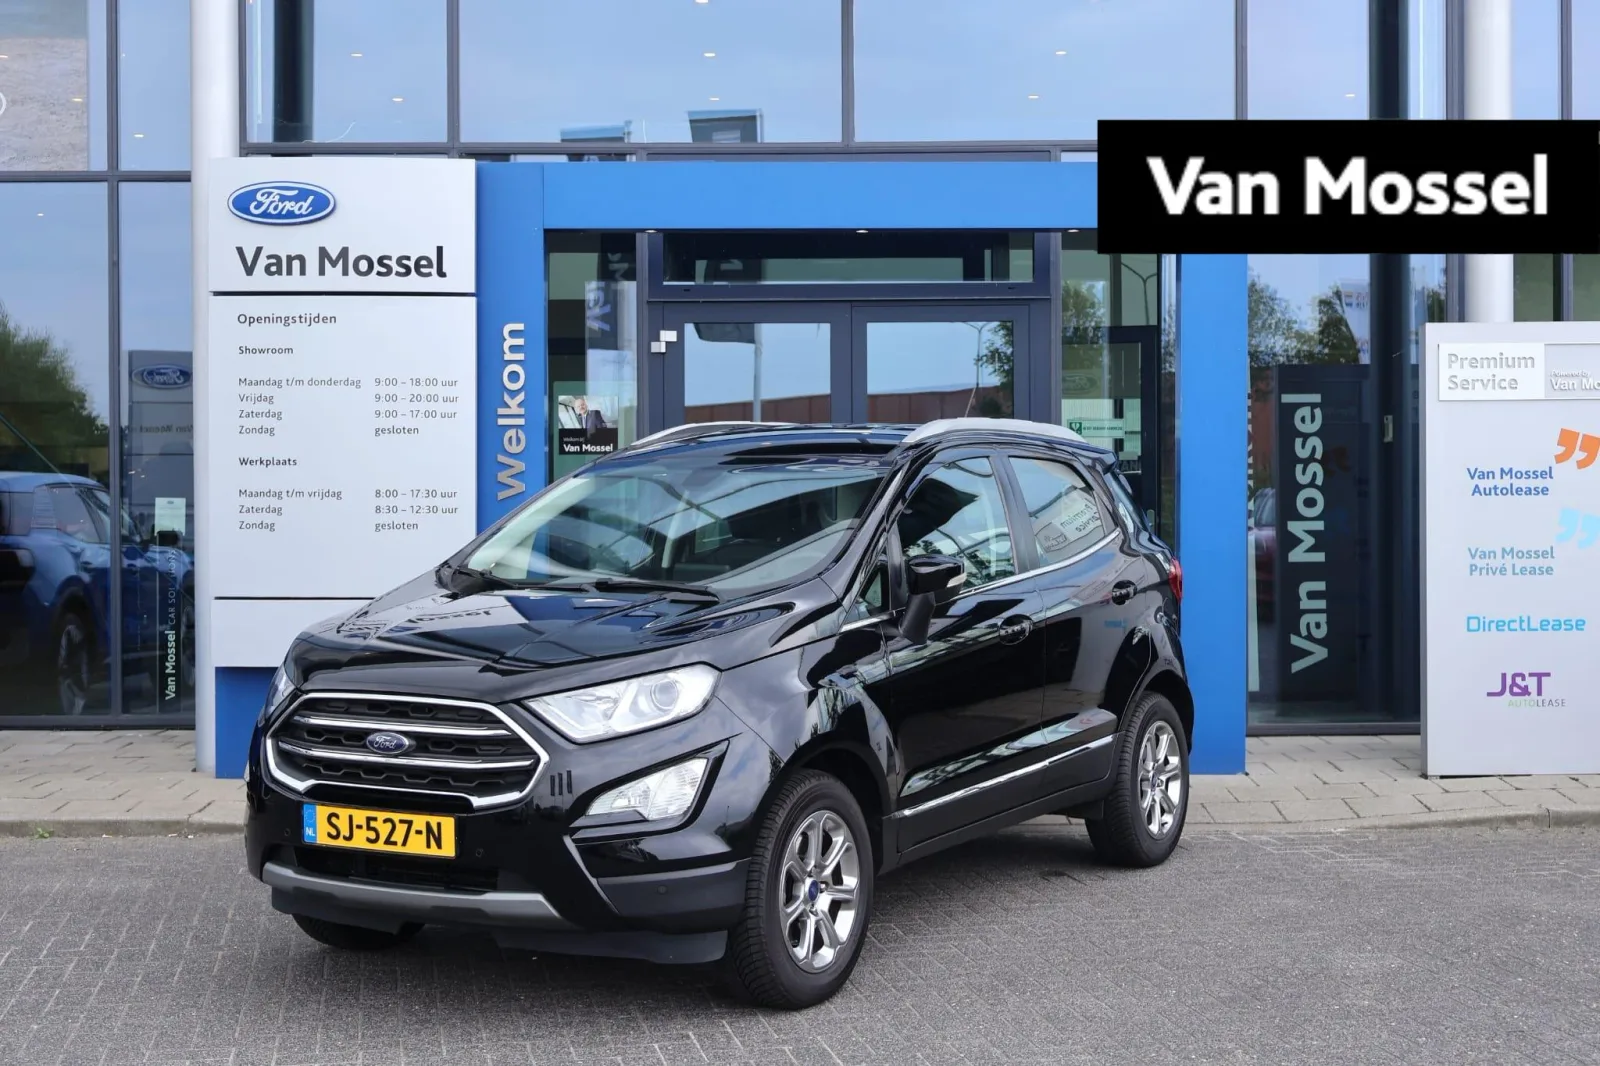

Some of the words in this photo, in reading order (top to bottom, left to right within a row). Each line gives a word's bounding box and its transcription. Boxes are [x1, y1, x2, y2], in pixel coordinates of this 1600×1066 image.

[235, 246, 306, 277] Van
[318, 245, 447, 278] Mossel
[237, 312, 337, 327] Openingstijden
[238, 345, 294, 355] Showroom
[1447, 352, 1535, 369] Premium
[238, 377, 283, 389] Maandag
[286, 377, 305, 387] t/m
[307, 377, 362, 390] donderdag
[375, 378, 397, 387] 9:00
[410, 378, 438, 387] 18:00
[1447, 374, 1519, 391] Service
[1550, 378, 1576, 391] Van
[238, 393, 275, 406] Vrijdag
[375, 394, 397, 403] 9:00
[410, 394, 439, 403] 20:00
[238, 409, 283, 421] Zaterdag
[375, 410, 397, 419] 9:00
[410, 410, 438, 419] 17:00
[497, 323, 526, 501] Welkom
[238, 425, 275, 437] Zondag
[374, 425, 420, 437] gesloten
[563, 443, 580, 452] Van
[582, 443, 613, 452] Mossel
[238, 456, 298, 469] Werkplaats
[1280, 393, 1325, 562] Mossel
[1467, 467, 1496, 480] Van
[1500, 466, 1554, 480] Mossel
[238, 488, 283, 501] Maandag
[286, 488, 305, 498] t/m
[307, 488, 343, 501] vrijdag
[375, 489, 397, 498] 8:00
[410, 489, 438, 498] 17:30
[1471, 483, 1550, 497] Autolease
[238, 504, 283, 516] Zaterdag
[375, 505, 397, 514] 8:30
[410, 505, 439, 514] 12:30
[238, 520, 275, 532] Zondag
[374, 520, 419, 533] gesloten
[1467, 546, 1497, 560] Van
[1501, 546, 1556, 560] Mossel
[1469, 562, 1508, 577] Privé
[1511, 562, 1554, 576] Lease
[168, 607, 176, 625] CAR
[1289, 580, 1328, 674] Van
[1466, 615, 1587, 633] DirectLease
[164, 630, 176, 673] Mossel
[165, 677, 176, 700] Van
[1486, 672, 1551, 697] J&T
[1507, 698, 1566, 708] AUTOLEASE
[305, 826, 316, 837] NL
[326, 812, 442, 850] SJ-527-N
